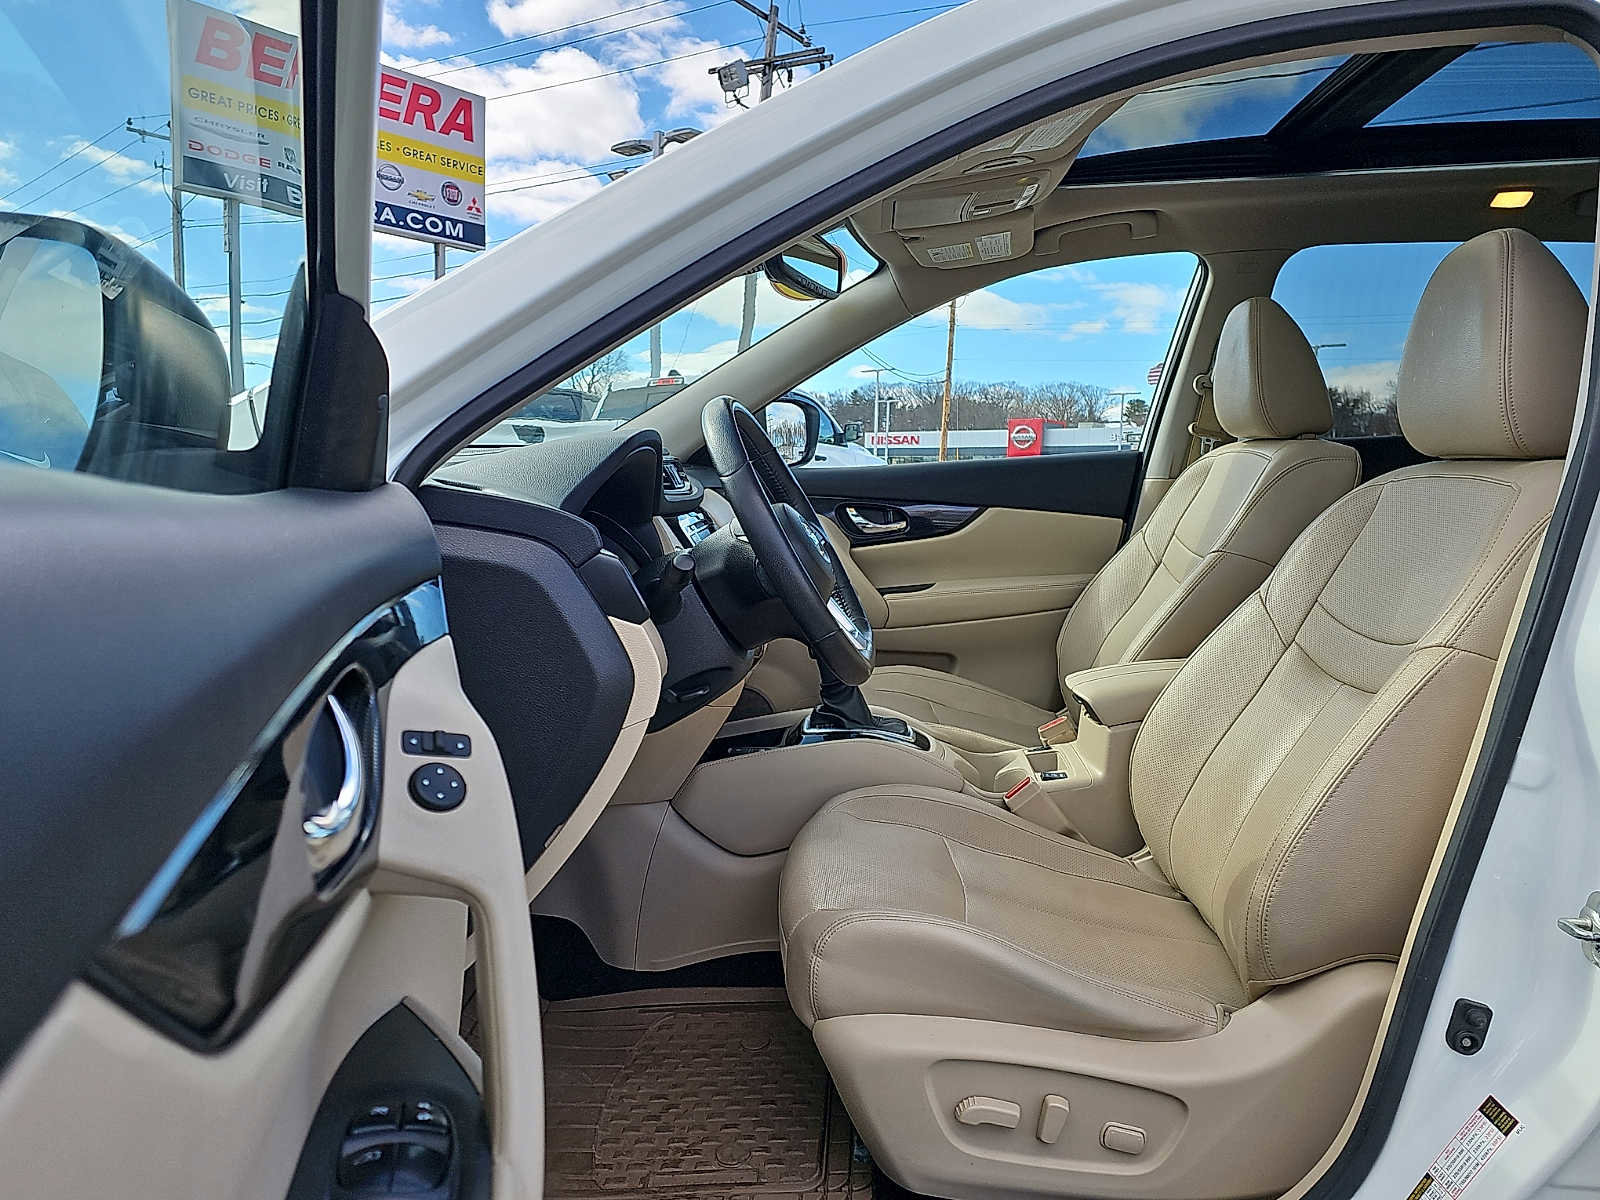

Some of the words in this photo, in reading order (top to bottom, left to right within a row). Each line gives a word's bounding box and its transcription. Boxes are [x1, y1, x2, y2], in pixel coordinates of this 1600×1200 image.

[188, 87, 233, 109] GREAT
[238, 101, 279, 121] PRICES
[188, 139, 271, 169] DODGE
[402, 146, 437, 164] GREAT
[440, 156, 484, 176] SERVICE
[223, 172, 268, 193] Visit
